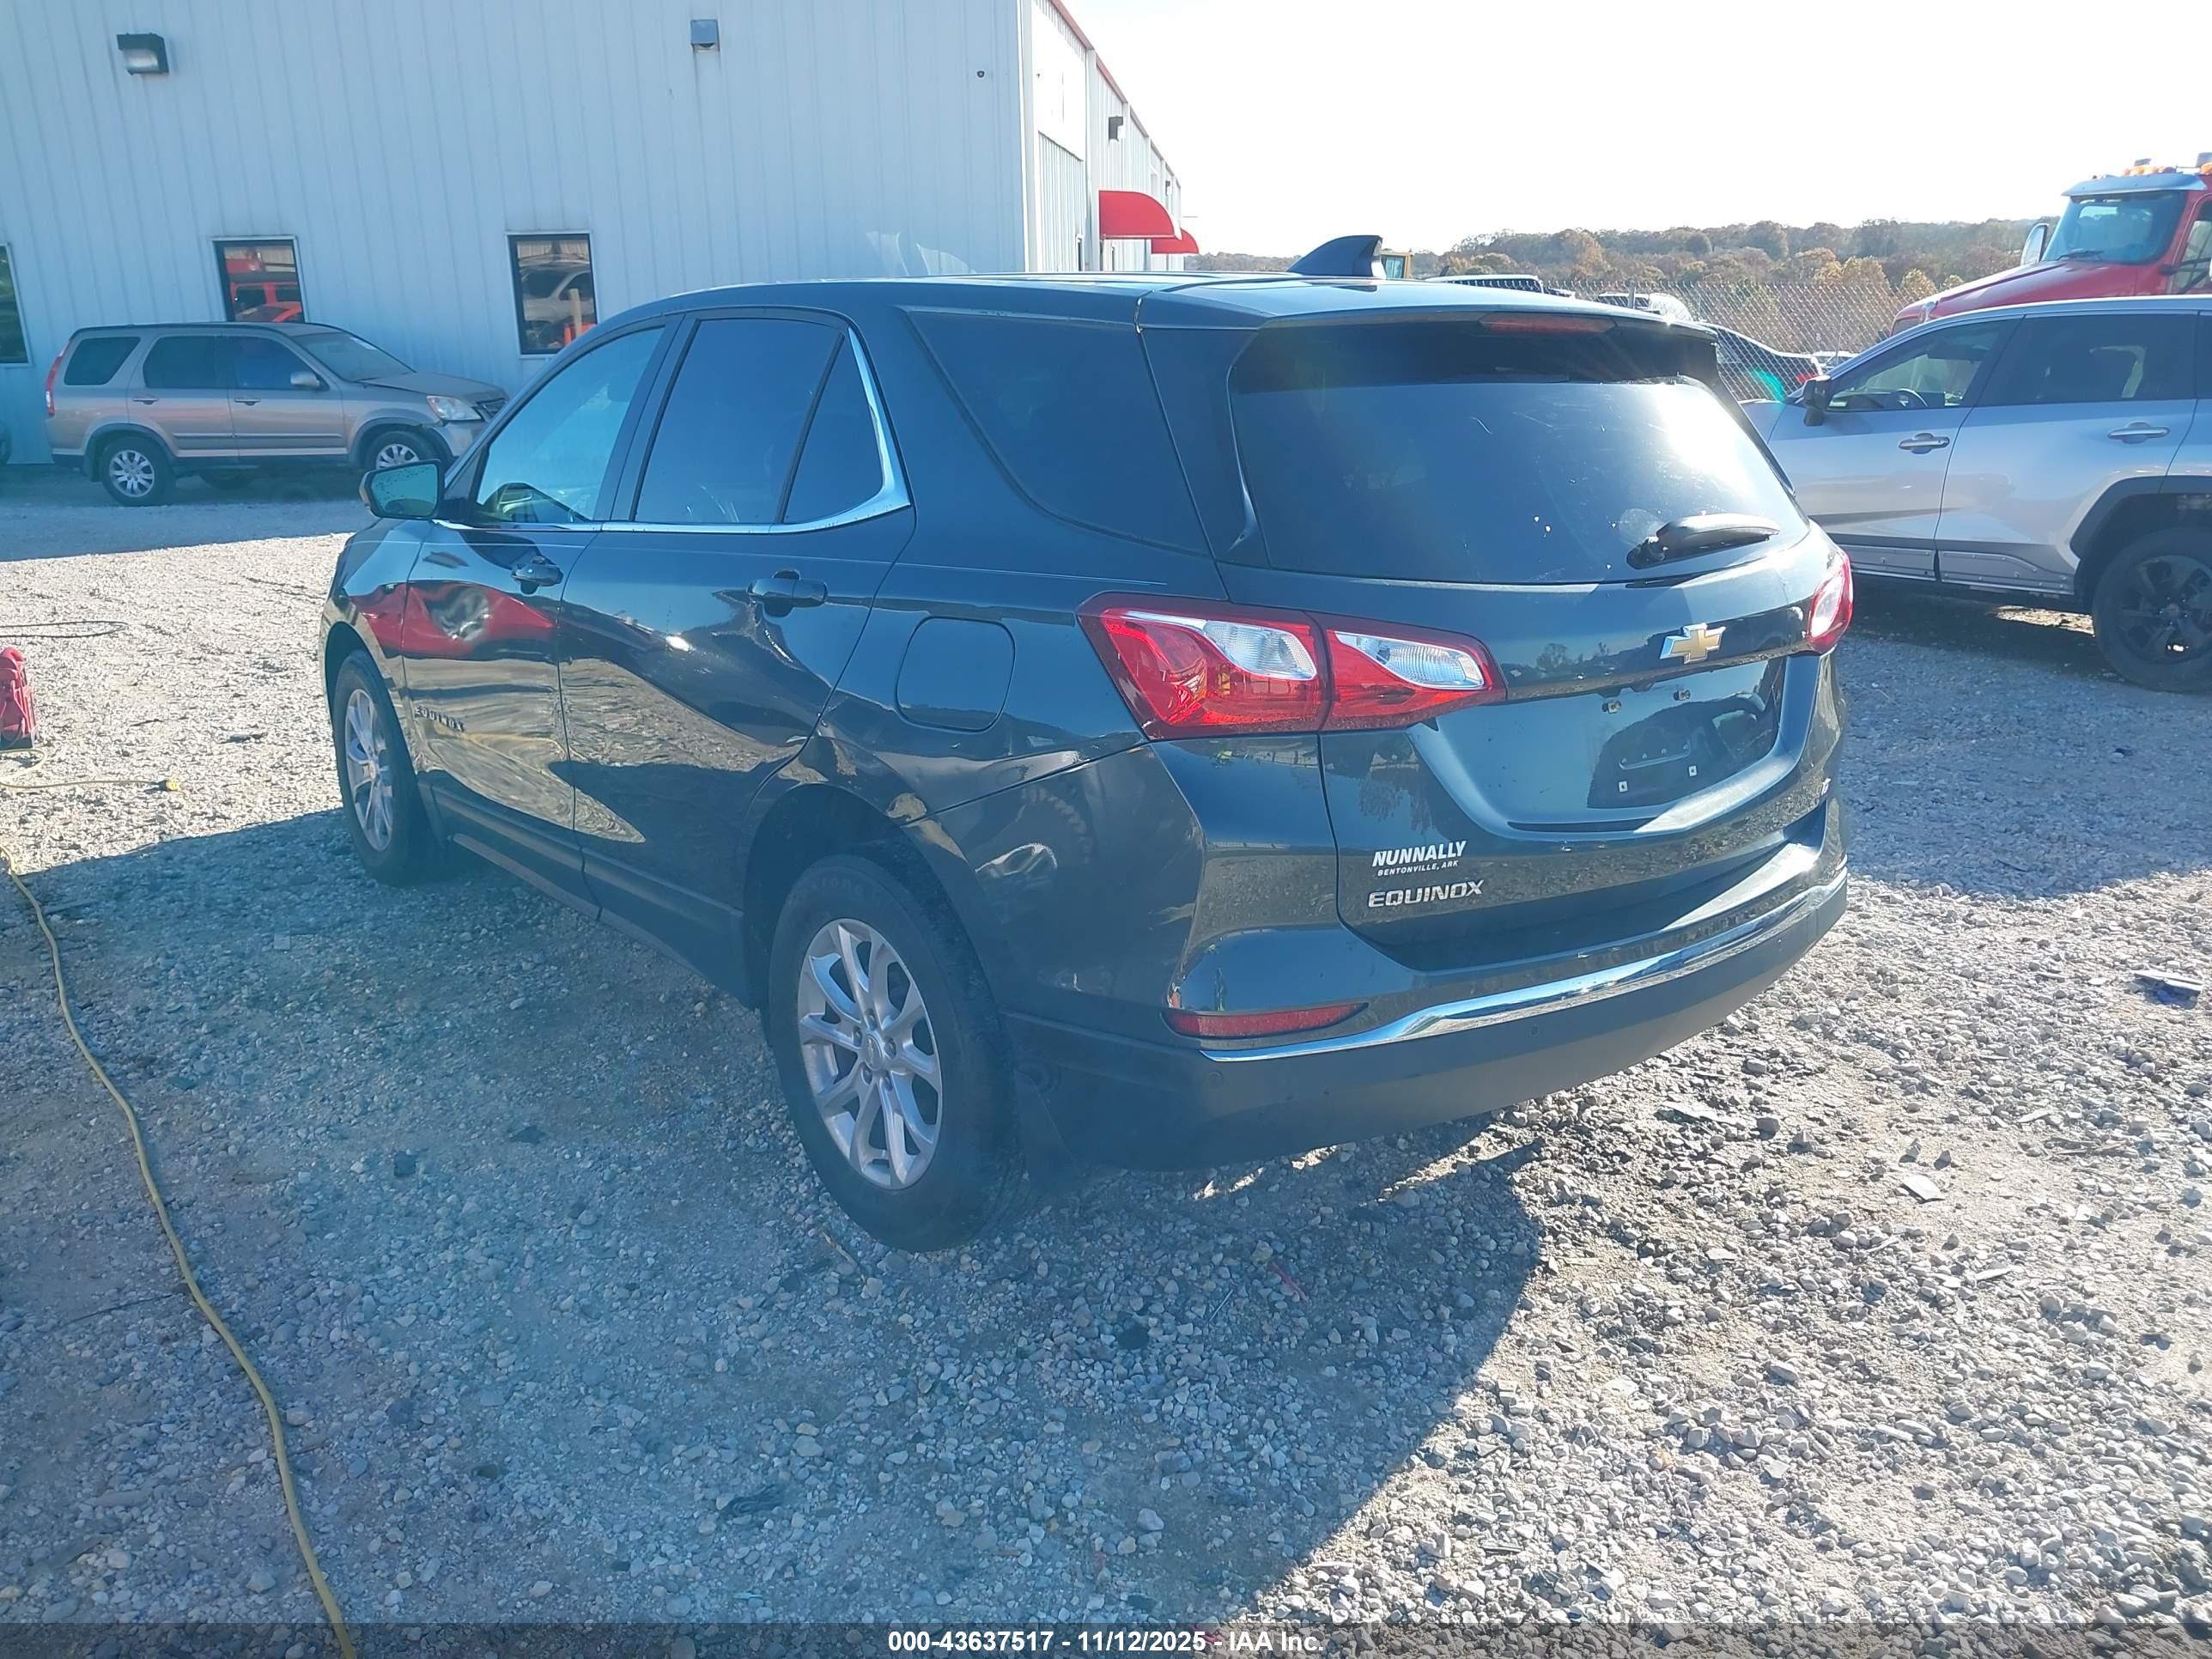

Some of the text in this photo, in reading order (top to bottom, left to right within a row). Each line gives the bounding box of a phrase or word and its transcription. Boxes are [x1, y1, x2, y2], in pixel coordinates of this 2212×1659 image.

[1371, 840, 1468, 867] NUNNALLY
[1376, 860, 1459, 877] BENTONVILLE, ARK
[1367, 878, 1485, 908] EQUINOX
